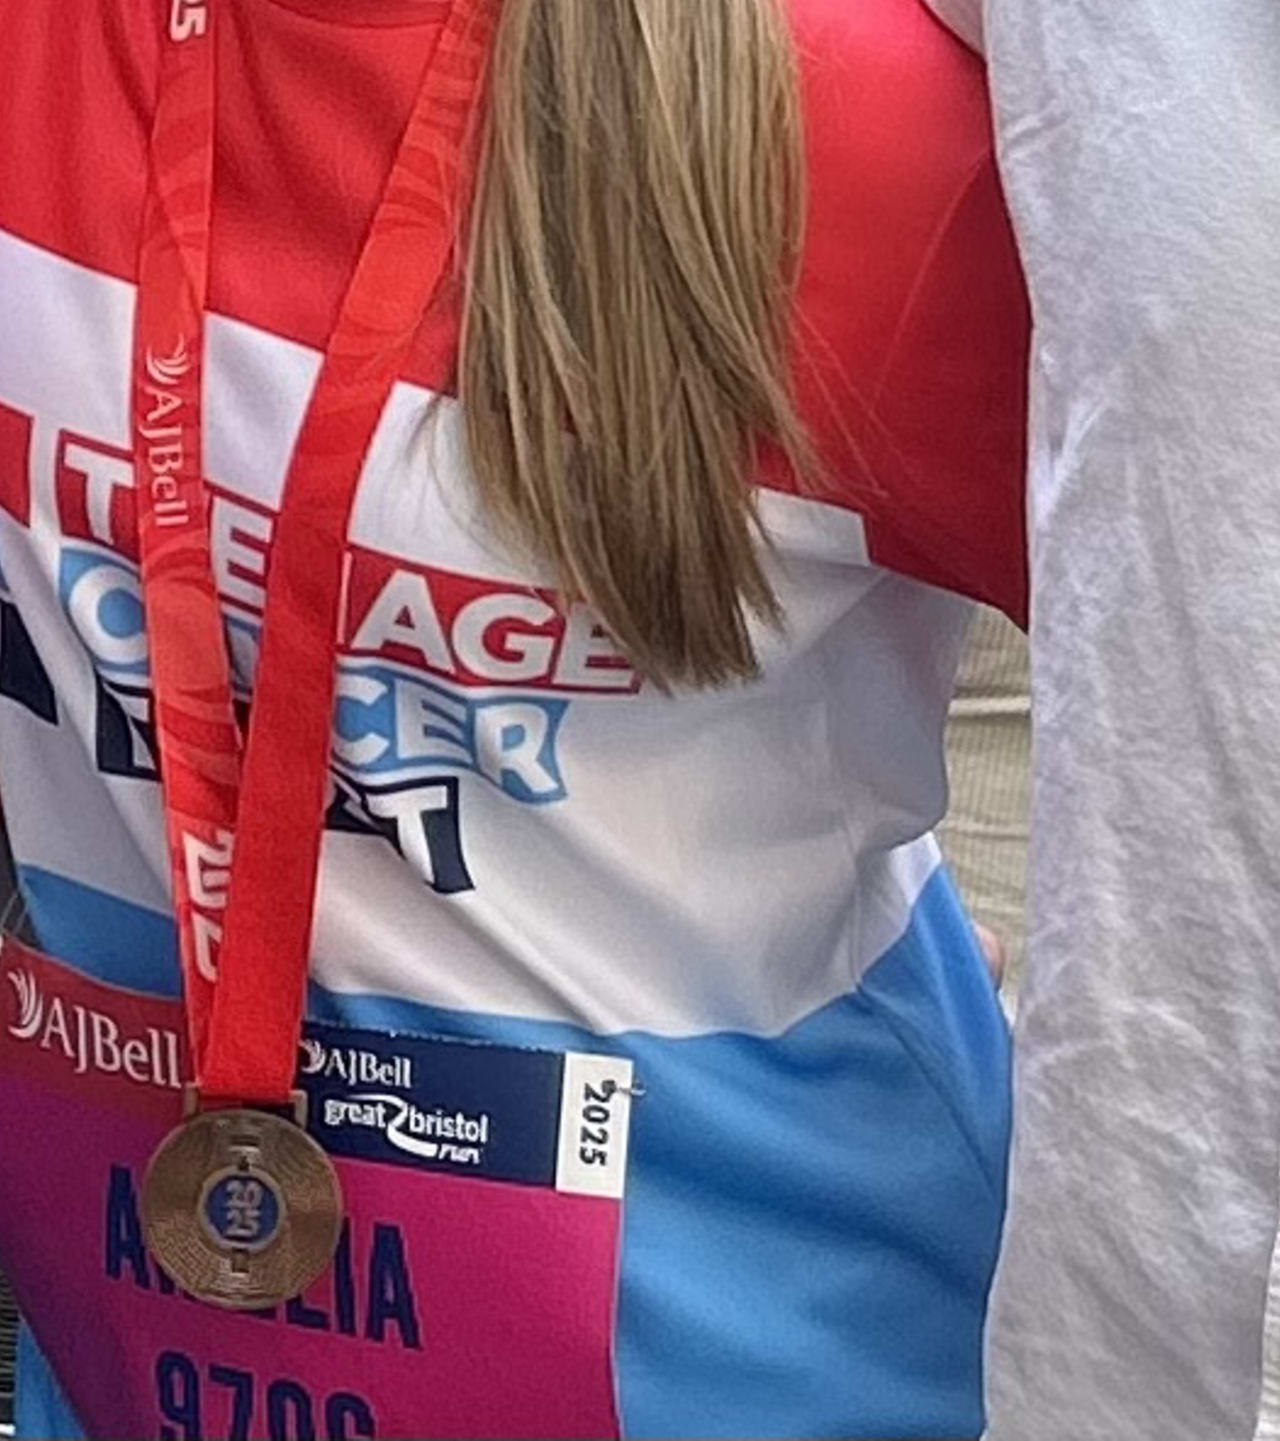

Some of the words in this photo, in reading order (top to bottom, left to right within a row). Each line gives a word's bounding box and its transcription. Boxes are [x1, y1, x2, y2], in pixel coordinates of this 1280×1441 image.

[138, 387, 189, 526] AJBell
[40, 997, 182, 1089] AJBell
[324, 1047, 412, 1089] AJBell
[324, 1099, 386, 1127] great
[410, 1110, 489, 1144] bristol
[438, 1144, 481, 1165] run
[579, 1079, 620, 1167] 2025
